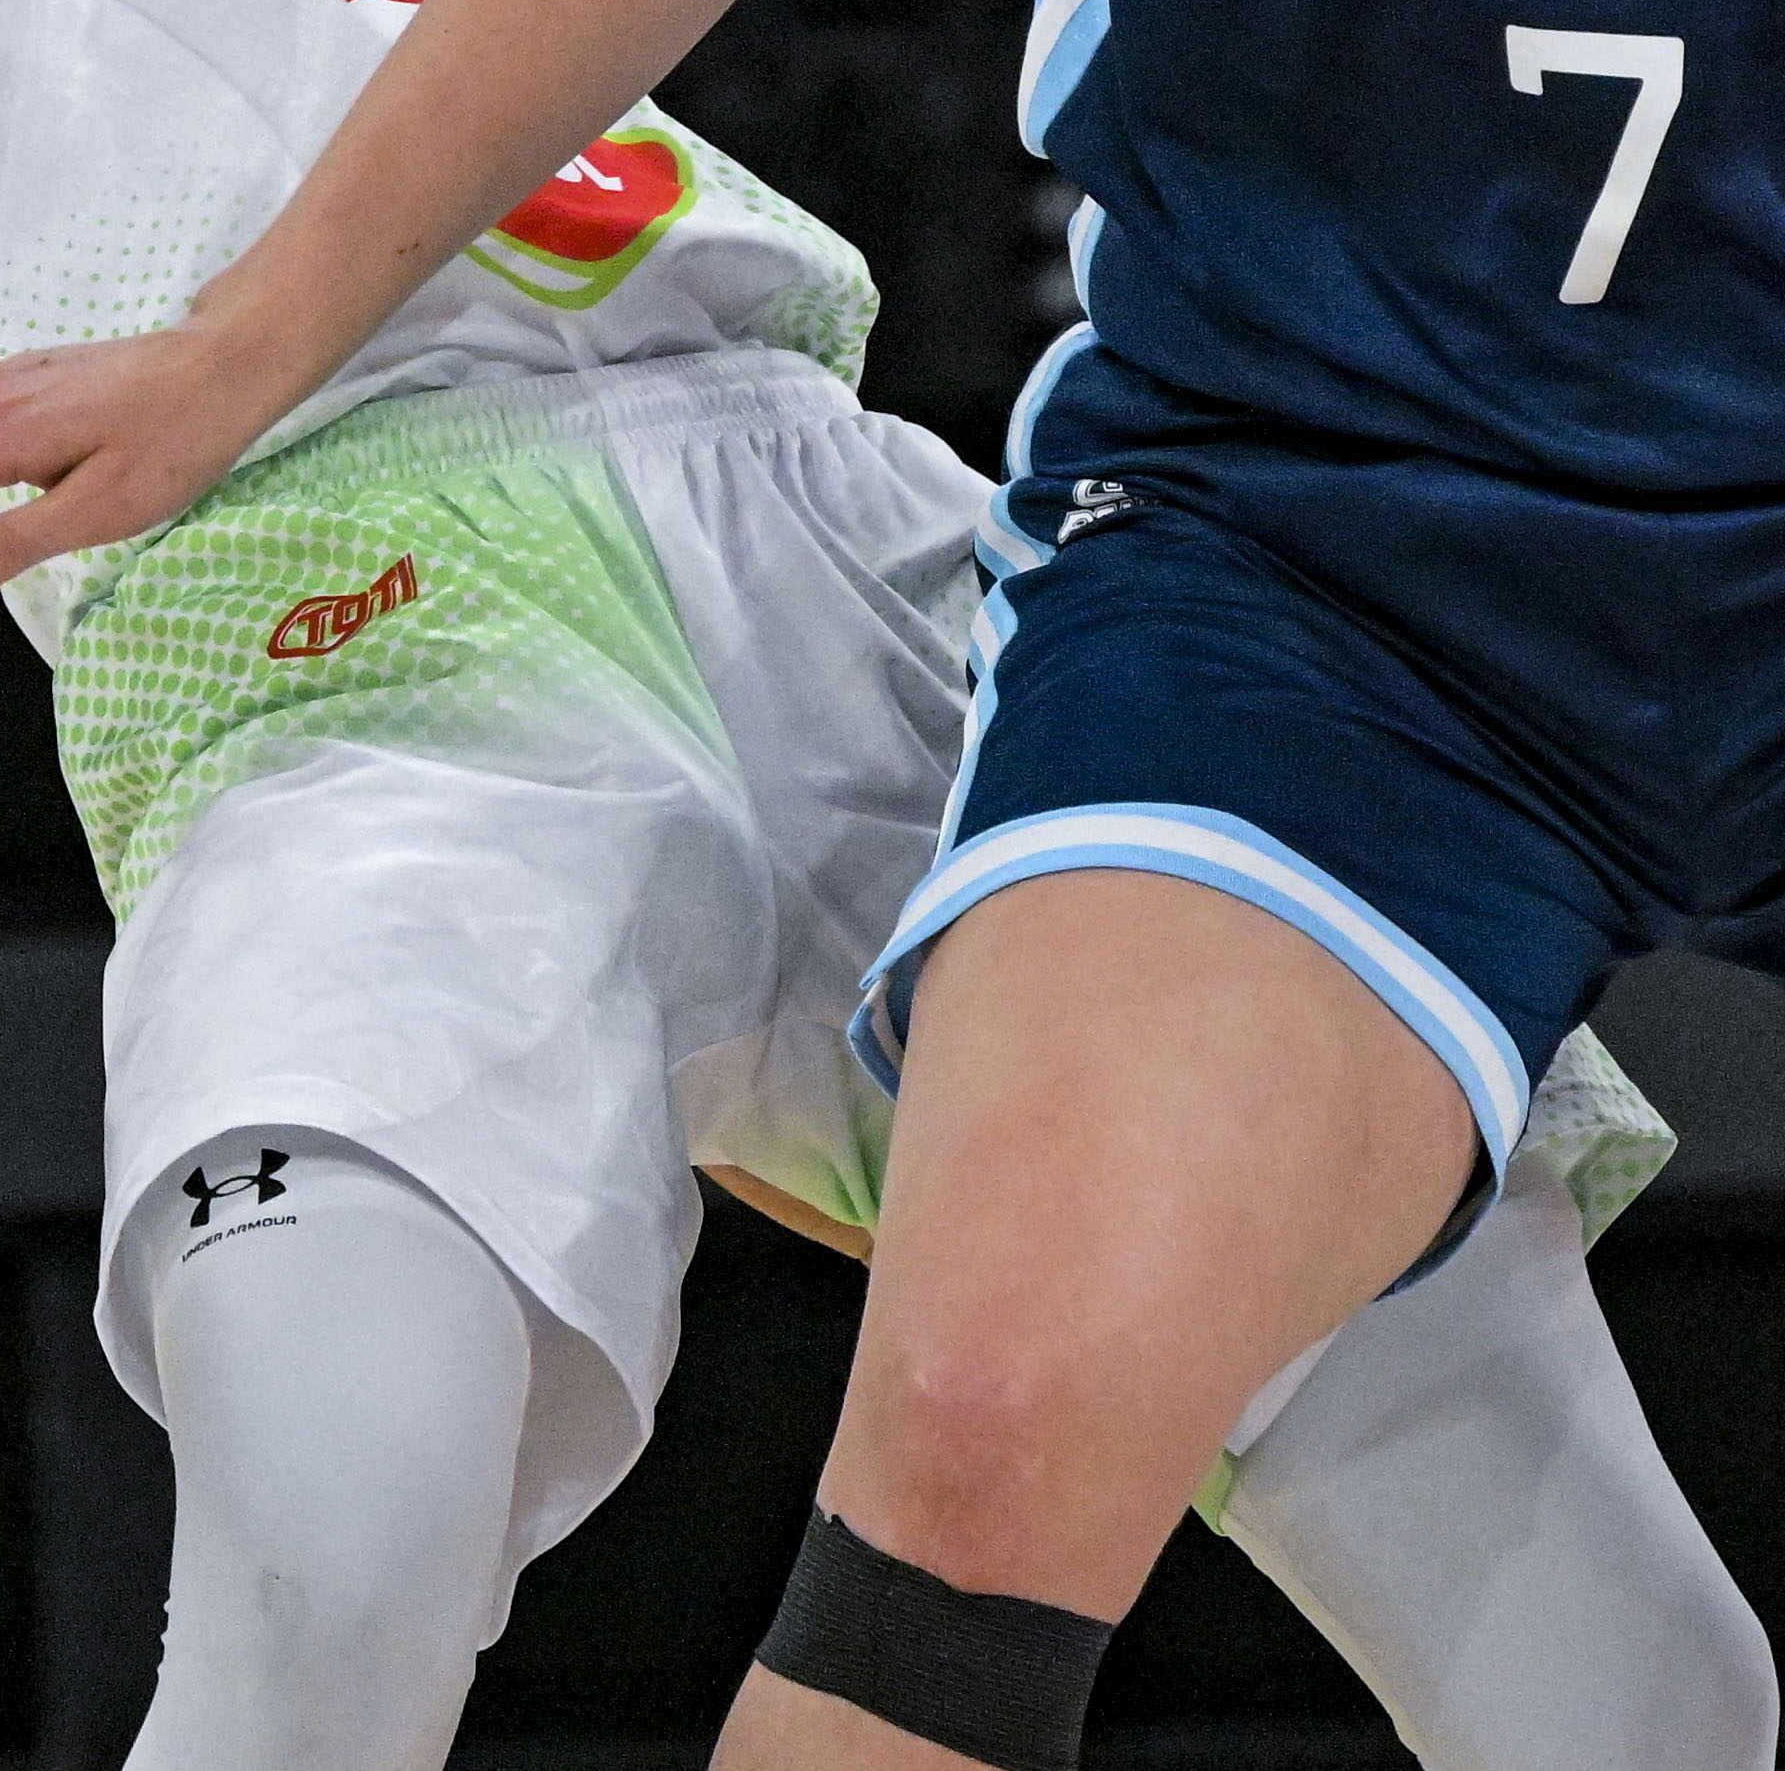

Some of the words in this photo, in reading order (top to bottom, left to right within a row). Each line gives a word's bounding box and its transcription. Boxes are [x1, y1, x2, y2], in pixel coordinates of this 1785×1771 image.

[1506, 25, 1684, 304] 7
[182, 1232, 223, 1264] UNDER
[225, 1215, 298, 1239] ARMOUR
